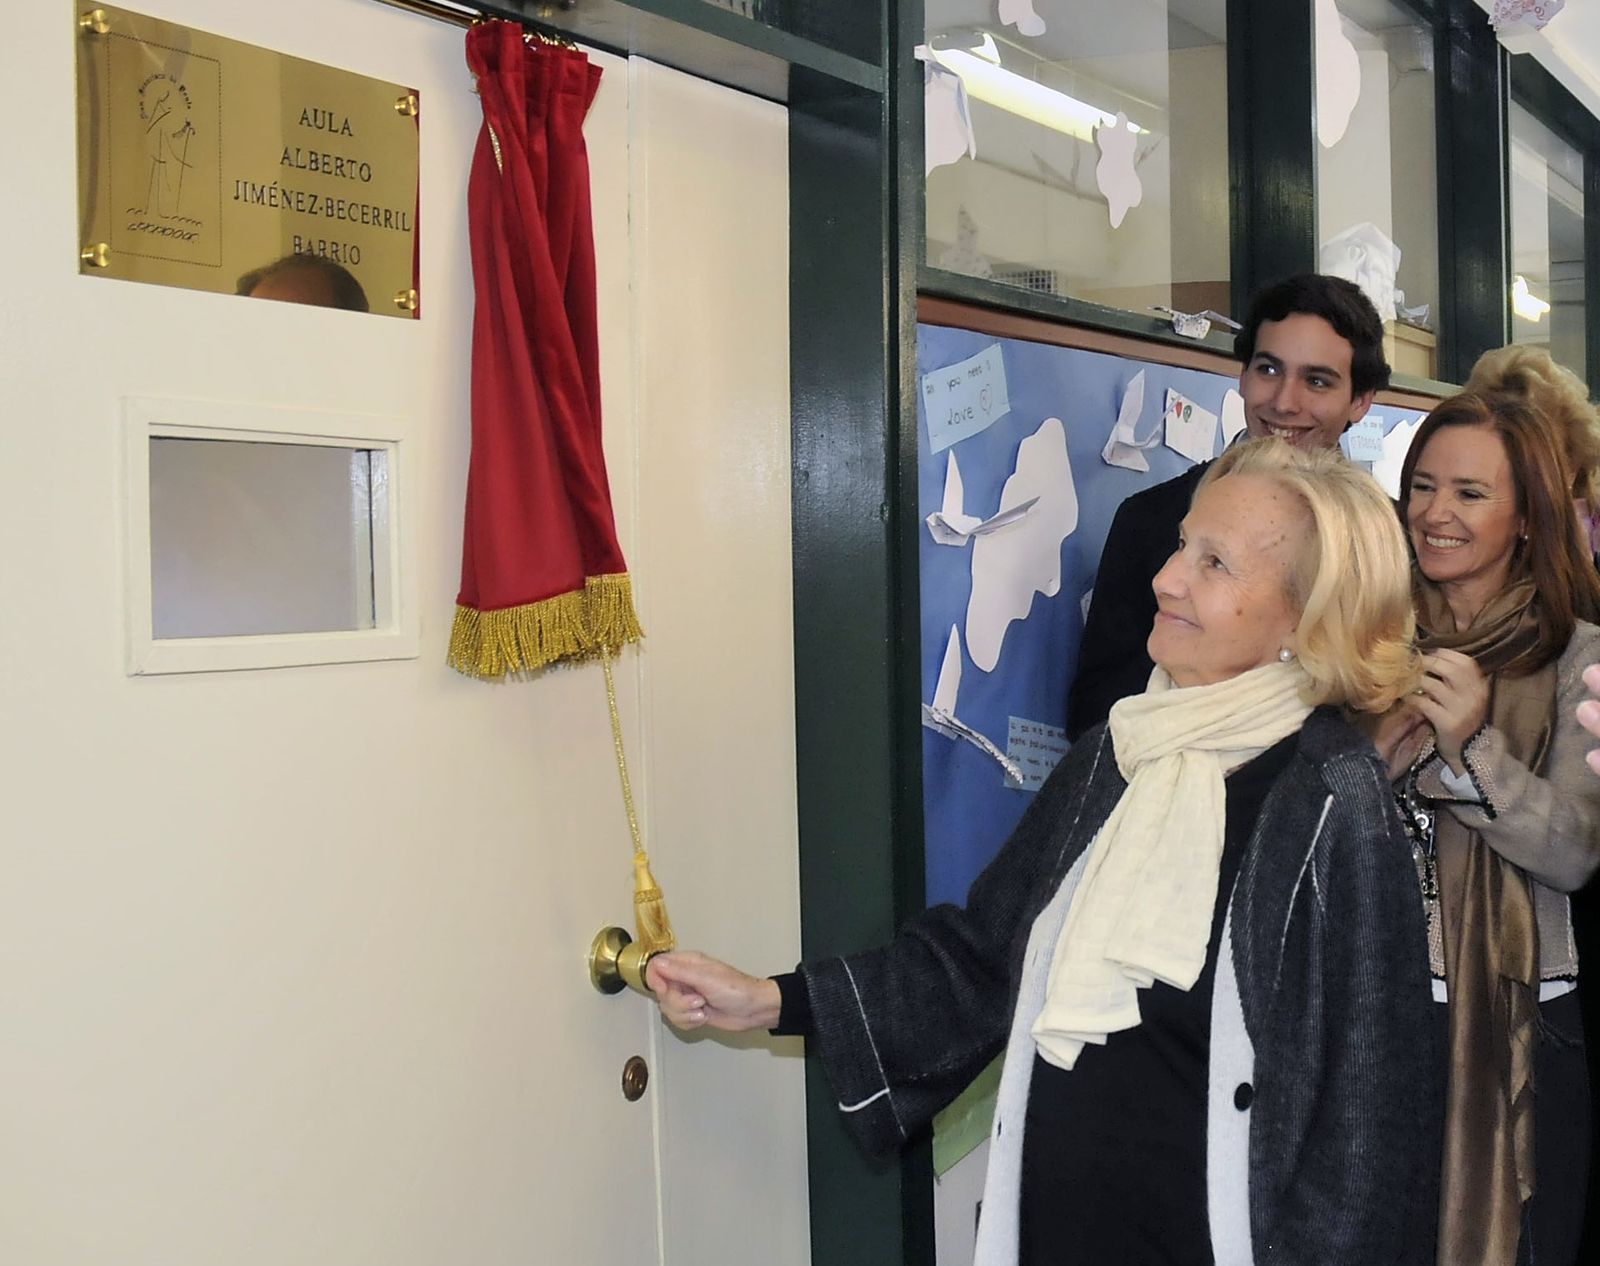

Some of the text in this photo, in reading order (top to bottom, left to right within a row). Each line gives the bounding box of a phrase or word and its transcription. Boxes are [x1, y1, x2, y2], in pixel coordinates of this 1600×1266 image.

[298, 107, 354, 137] AULA
[279, 146, 372, 183] ALBERTO
[293, 235, 361, 266] BARRIO
